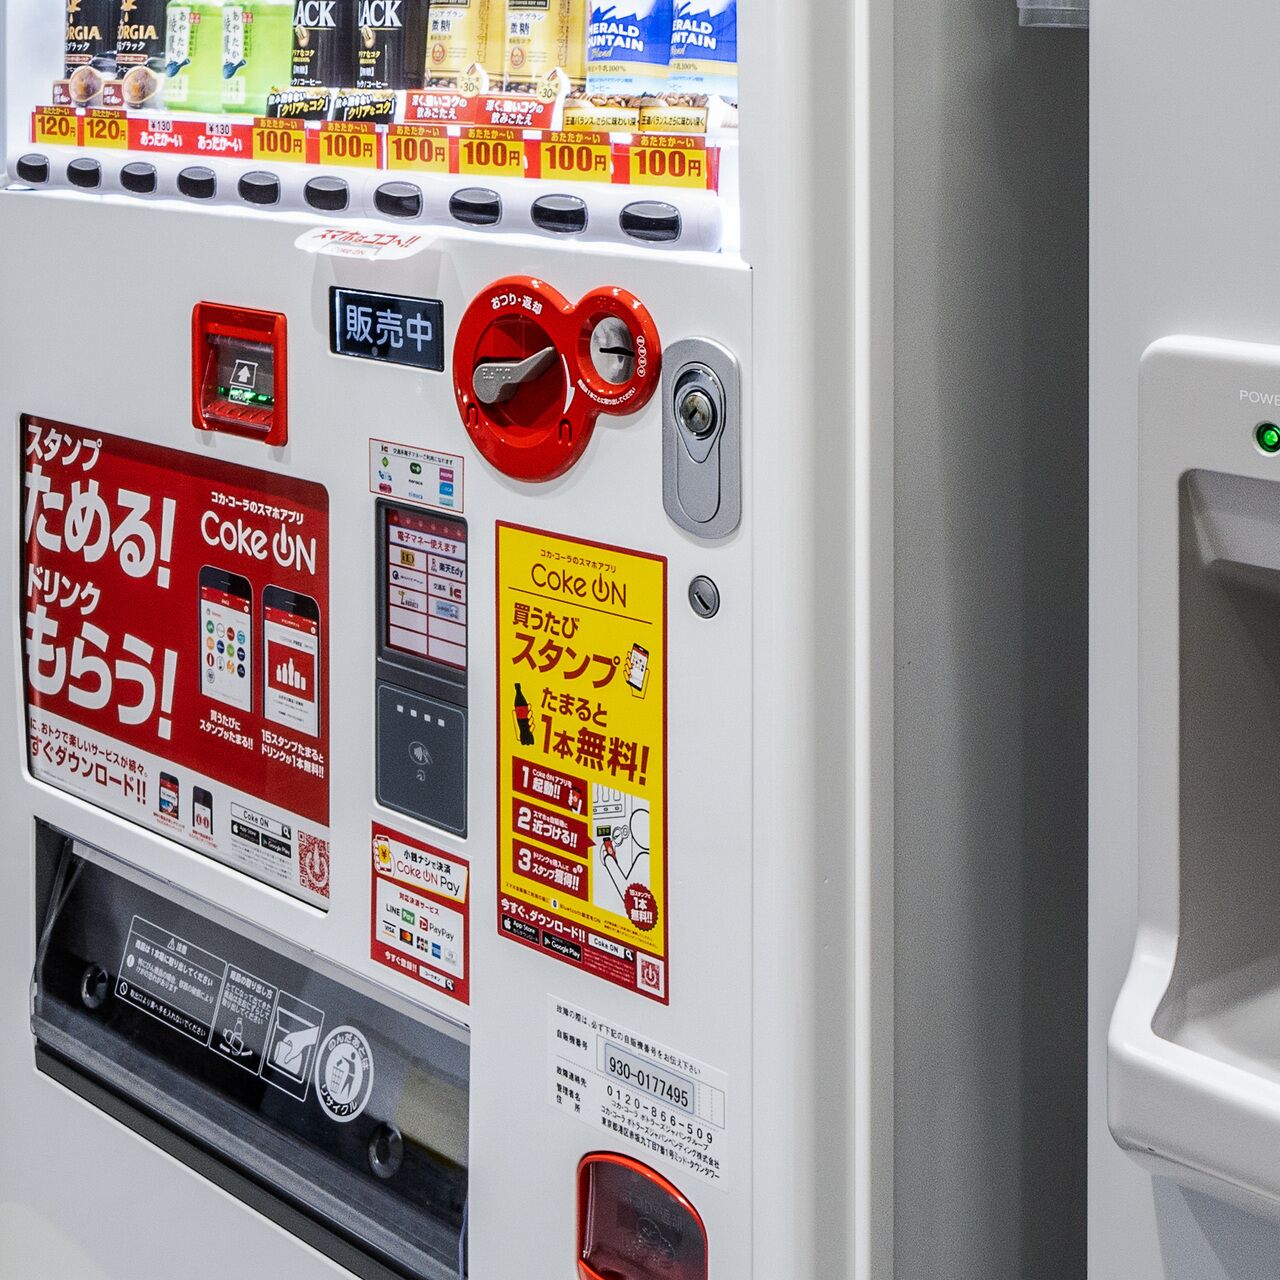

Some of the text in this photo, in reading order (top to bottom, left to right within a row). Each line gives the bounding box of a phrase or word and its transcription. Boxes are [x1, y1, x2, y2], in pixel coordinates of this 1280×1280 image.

[37, 118, 76, 137] 120円
[87, 120, 126, 140] 120円
[150, 121, 172, 132] ¥130
[208, 123, 230, 136] ¥130
[140, 131, 183, 148] あったか〜い
[197, 134, 243, 152] あったか〜い
[256, 129, 302, 154] 100円
[323, 134, 373, 158] 100円
[392, 138, 445, 161] 100円
[640, 135, 695, 148] あたたか〜い
[463, 141, 521, 166] 100円
[545, 145, 607, 172] 100円
[635, 150, 701, 176] 100円
[490, 293, 543, 316] おつり・返却
[345, 303, 434, 352] 販売中
[26, 425, 102, 473] スタンプ
[210, 491, 304, 525] コカ・コーラのスマホアプリ
[25, 463, 177, 589] ためる!
[201, 510, 316, 576] Coke ON
[397, 531, 458, 553] 電子マネー使えます
[540, 549, 616, 573] コカ・コーラのスマホアプリ
[28, 565, 102, 616] ドリンク
[531, 563, 627, 608] Coke ON
[513, 602, 579, 639] 買うたび
[26, 604, 178, 741] もらう!
[512, 632, 620, 689] スタンプ
[541, 687, 608, 727] たまると
[210, 709, 241, 732] 買うたびに
[200, 718, 253, 750] スタンプがたまる!!
[261, 728, 324, 765] 15スタンプたまると
[541, 715, 650, 786] 1本無料!
[522, 766, 528, 788] 1
[532, 780, 561, 800] 起動!!
[243, 810, 260, 823] Coke
[518, 806, 531, 830] 2
[532, 820, 577, 847] 近づける!!
[404, 850, 451, 875] 小銭ナシで決済
[518, 848, 531, 871] 3
[397, 861, 460, 896] Coke ON Pay
[532, 864, 579, 891] スタンプ獲得!!
[386, 904, 400, 917] LINE
[634, 897, 647, 910] 1本
[501, 898, 585, 943] 今すぐ、ダウンロード!!
[631, 910, 653, 923] 無料!!
[429, 922, 454, 941] PayPay
[594, 937, 608, 949] Coke
[609, 1055, 689, 1108] 930-0177495
[321, 1084, 357, 1115] リサイクル
